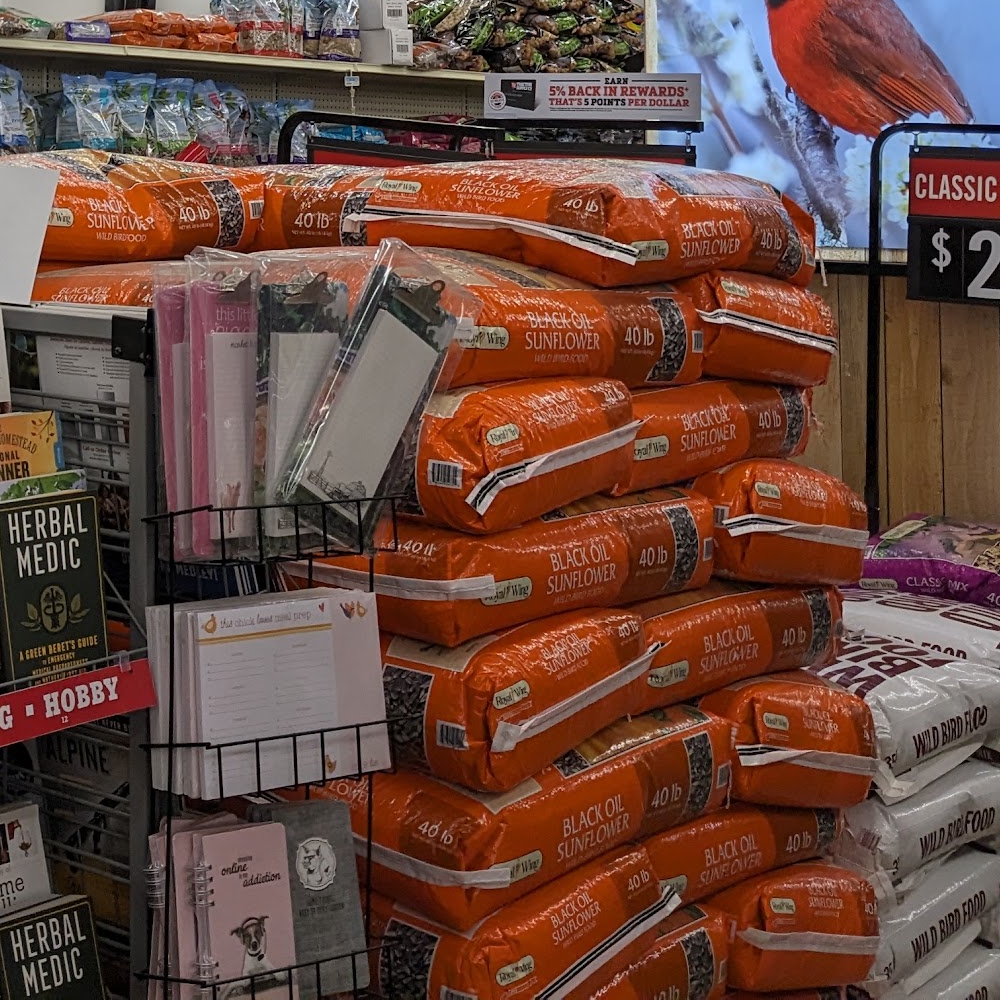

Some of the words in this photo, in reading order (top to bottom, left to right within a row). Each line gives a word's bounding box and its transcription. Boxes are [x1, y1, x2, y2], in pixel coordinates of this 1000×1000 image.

[549, 86, 566, 96] 5%
[568, 86, 600, 97] BACK
[603, 86, 617, 97] IN
[604, 77, 629, 85] EARN
[549, 98, 583, 106] THAT'S
[584, 98, 589, 106] 5
[590, 98, 626, 106] POINTS
[628, 98, 647, 107] PER
[649, 98, 690, 107] DOLLAR
[402, 183, 417, 193] Wing
[450, 184, 520, 200] SUNFLOWER
[461, 178, 496, 189] BLACK
[500, 182, 519, 192] OIL
[915, 173, 998, 203] CLASSIC
[56, 212, 71, 225] Wing
[680, 238, 740, 260] SUNFLOWER
[931, 227, 952, 273] $
[967, 229, 1000, 300] 2
[216, 306, 235, 321] this
[525, 331, 600, 350] SUNFLOWER
[624, 326, 642, 347] 40
[643, 326, 655, 347] lb
[680, 424, 736, 452] SUNFLOWER
[7, 503, 89, 544] HERBAL
[16, 537, 81, 578] MEDIC
[550, 548, 589, 572] BLACK
[590, 543, 611, 563] OIL
[639, 547, 655, 567] 40
[657, 545, 668, 565] lb
[546, 563, 616, 595] SUNFLOWER
[949, 579, 969, 592] MIX
[25, 646, 47, 660] GREEN
[77, 635, 99, 649] GUIDE
[43, 677, 119, 718] HOBBY
[61, 715, 69, 724] 12
[913, 726, 940, 759] WILD
[941, 715, 963, 747] BIRD
[651, 787, 670, 808] 40
[670, 783, 682, 802] lb
[562, 806, 602, 838] BLACK
[604, 794, 625, 818] OIL
[557, 813, 630, 862] SUNFLOWER
[920, 827, 945, 860] WILD
[964, 806, 996, 835] FOOD
[704, 841, 739, 867] BLACK
[740, 834, 758, 854] OIL
[221, 863, 248, 877] online
[242, 871, 281, 888] addiction
[552, 901, 602, 946] SUNFLOWER
[911, 926, 938, 963] WILD
[939, 908, 961, 945] BIRD
[962, 890, 987, 927] FOOD
[10, 911, 86, 962] HERBAL
[21, 949, 84, 997] MEDIC
